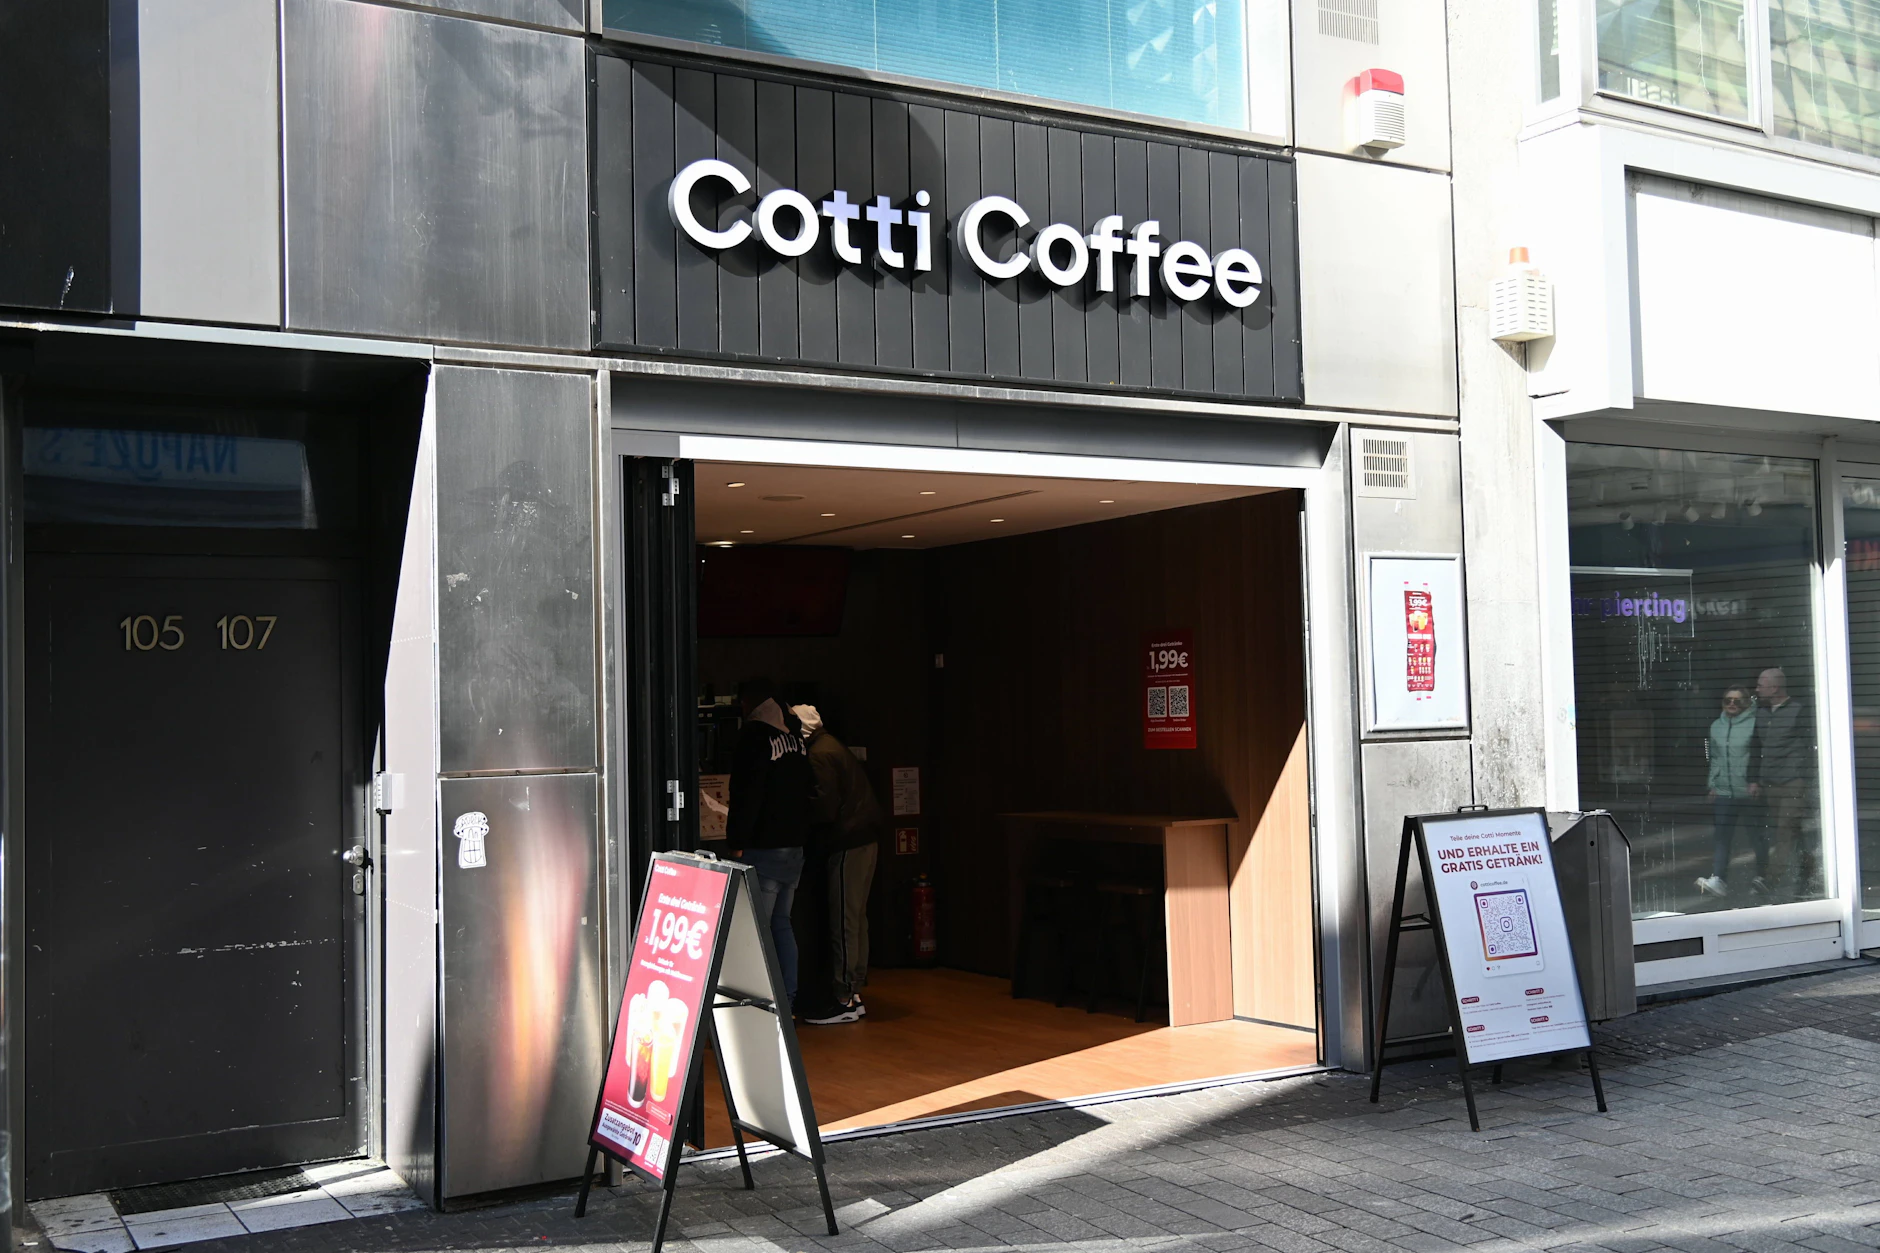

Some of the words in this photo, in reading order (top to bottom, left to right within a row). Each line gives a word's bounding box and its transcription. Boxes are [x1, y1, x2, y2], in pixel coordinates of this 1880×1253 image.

[668, 158, 932, 272] Cotti
[957, 195, 1263, 308] Coffee
[1601, 591, 1687, 624] piercing
[120, 615, 185, 651] 105
[216, 615, 278, 651] 107
[1148, 649, 1189, 673] 1,99€
[1464, 832, 1480, 841] deine
[1495, 830, 1521, 838] Momente
[1437, 848, 1464, 860] UND
[1467, 842, 1518, 858] ERHALTE
[1520, 841, 1540, 853] EIN
[1441, 859, 1484, 874] GRATIS
[1486, 853, 1543, 870] GETRÄNK!
[648, 908, 709, 960] 1,99€
[604, 1113, 636, 1134] Zusatzangebot
